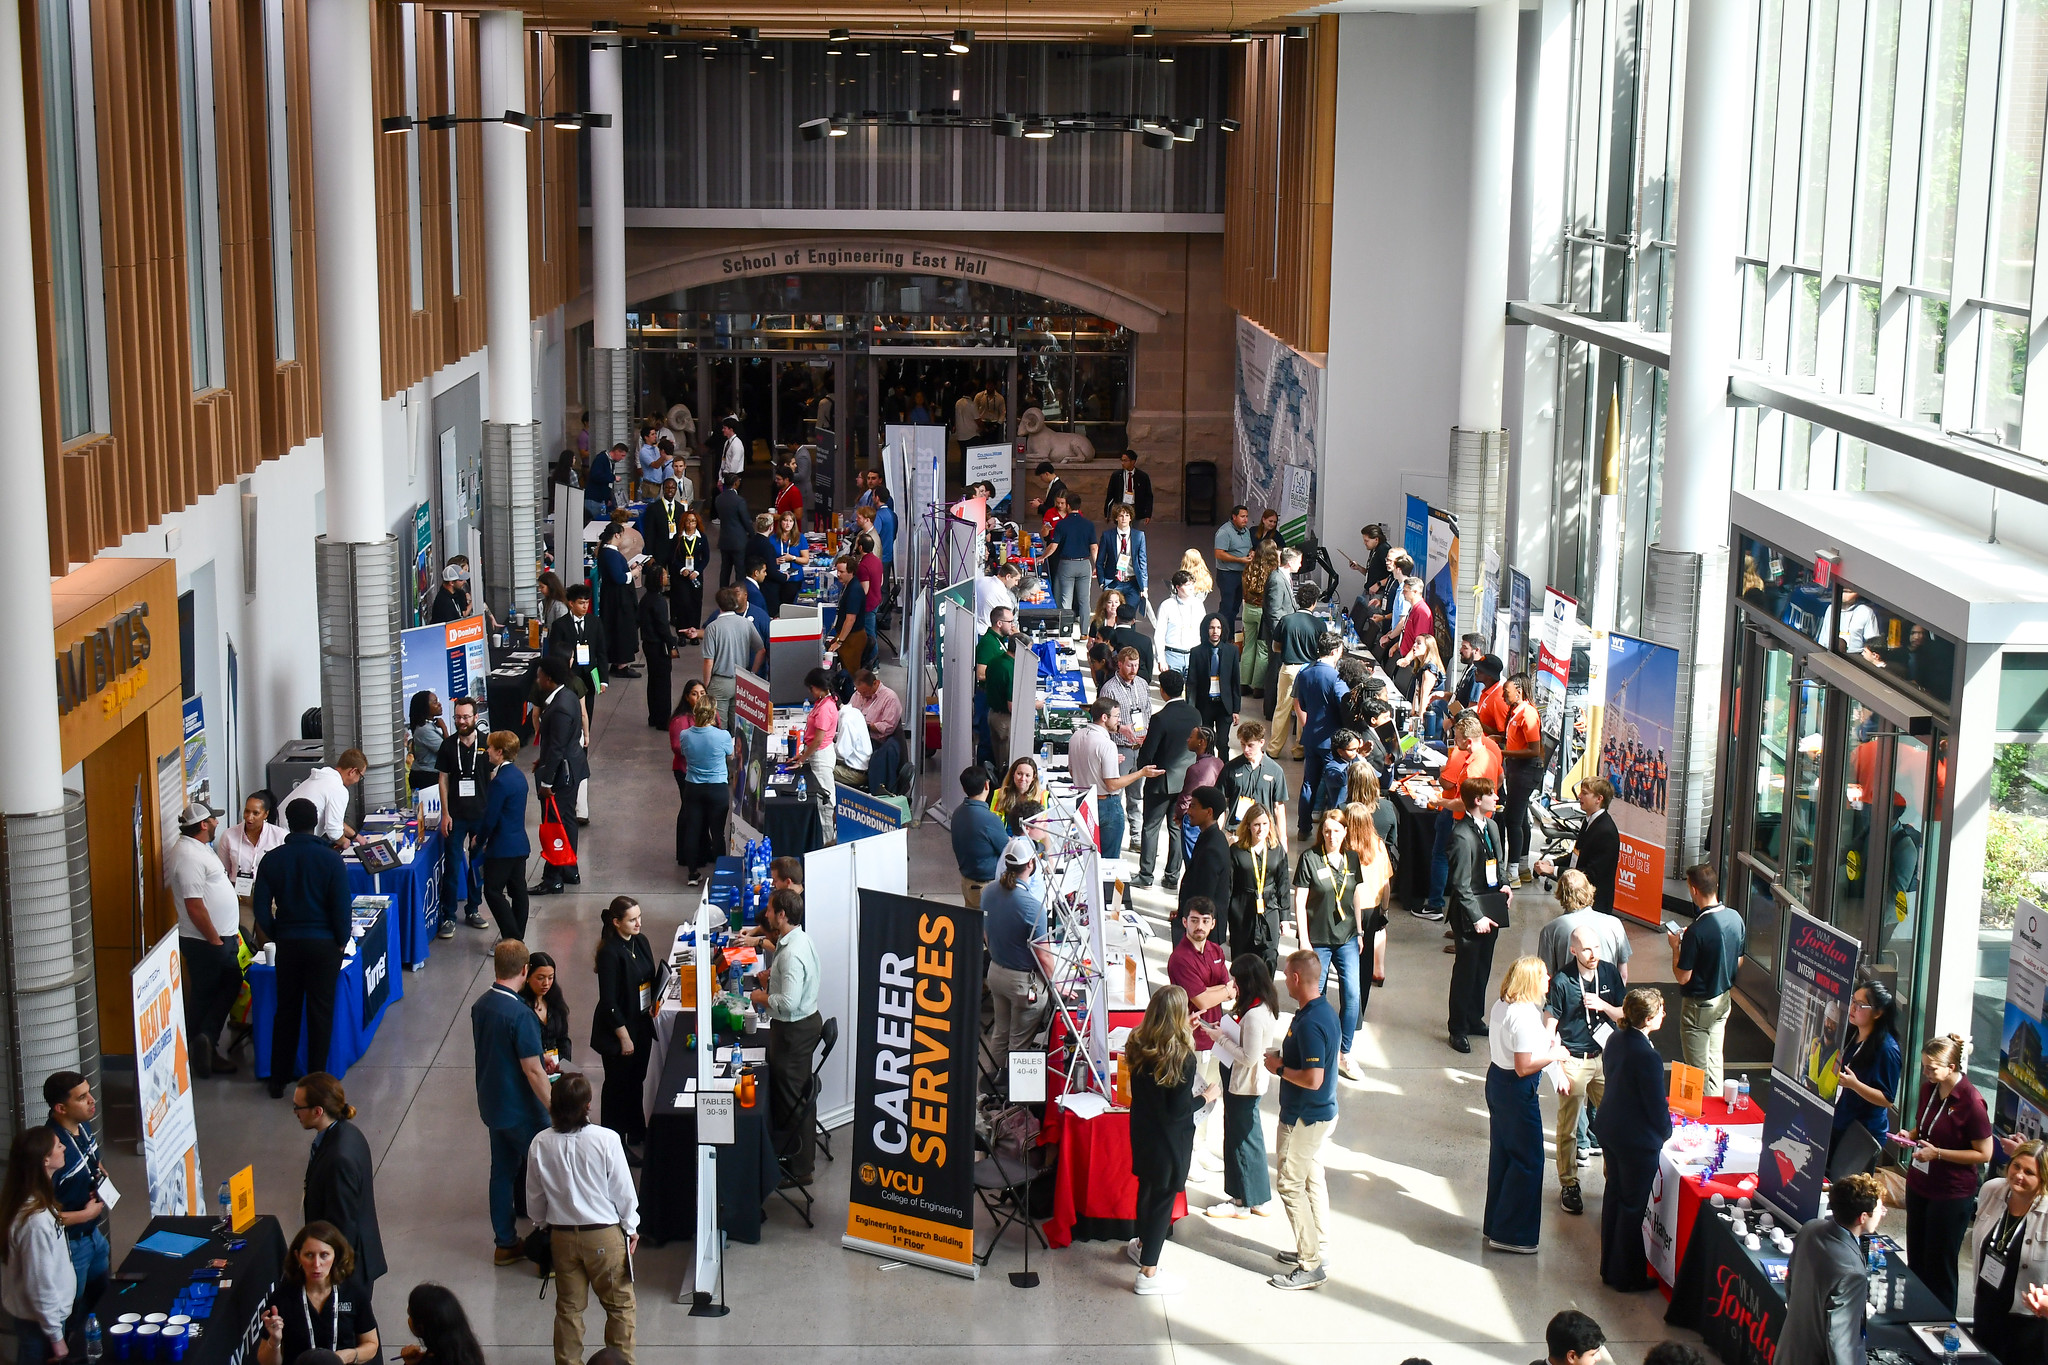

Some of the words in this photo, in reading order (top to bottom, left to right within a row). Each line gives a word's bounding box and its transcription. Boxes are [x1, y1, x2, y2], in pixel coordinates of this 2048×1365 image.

[722, 252, 776, 274] School
[784, 250, 800, 266] of
[808, 249, 904, 267] Engineering
[912, 251, 947, 268] East
[955, 256, 988, 276] Hall
[85, 602, 151, 694] BYTES
[1612, 636, 1625, 646] WT
[736, 686, 746, 697] Build
[746, 690, 754, 702] Your
[755, 696, 767, 709] Career
[741, 700, 758, 717] Richmond
[842, 798, 854, 807] LET'S
[855, 803, 868, 813] BUILD
[870, 809, 896, 824] SOMETHING
[1618, 852, 1650, 874] TURE
[1634, 849, 1650, 860] your
[1619, 868, 1636, 883] WT
[1796, 926, 1848, 964] Jordan
[365, 952, 387, 998] Turner
[1797, 961, 1815, 981] INTERN
[1831, 980, 1840, 994] US
[1791, 982, 1804, 994] INTERN
[1805, 989, 1826, 1008] EXPERIENCE
[140, 998, 160, 1054] HEAT
[158, 986, 171, 1030] UP
[873, 952, 915, 1154] CAREER
[910, 912, 955, 1168] SERVICES
[878, 1167, 923, 1195] VCU
[882, 1190, 908, 1204] College
[910, 1198, 918, 1206] of
[920, 1199, 963, 1218] Engineering
[856, 1215, 897, 1233] Engineering
[899, 1226, 931, 1240] Research
[934, 1234, 963, 1249] Building
[904, 1238, 925, 1250] Floor
[1706, 1265, 1776, 1365] Jorda
